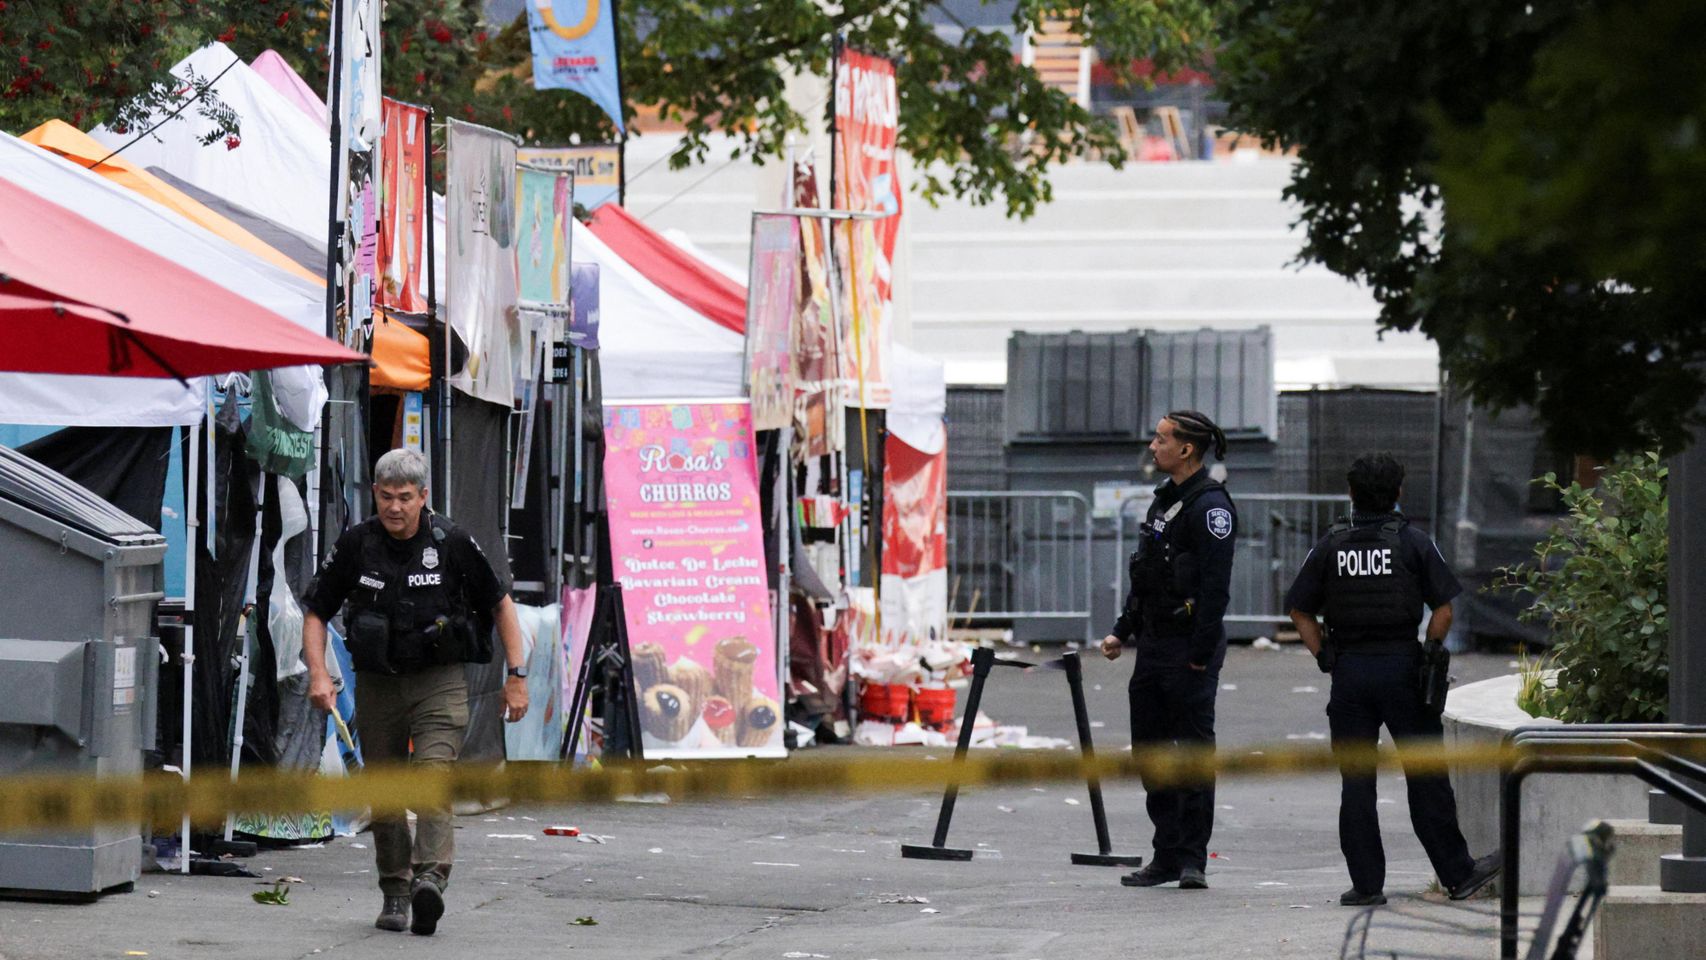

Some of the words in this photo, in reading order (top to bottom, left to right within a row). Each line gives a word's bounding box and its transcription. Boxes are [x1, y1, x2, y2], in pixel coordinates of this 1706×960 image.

[640, 444, 724, 472] Rosa's
[640, 482, 732, 502] CHURROS
[624, 557, 676, 573] Dulce
[681, 557, 706, 572] De
[712, 556, 759, 571] Leche
[1337, 549, 1392, 576] POLICE
[408, 573, 441, 587] POLICE
[619, 575, 698, 591] Bavarian
[704, 575, 761, 589] Cream
[653, 592, 736, 607] Chocolate
[647, 609, 746, 625] Strawberry
